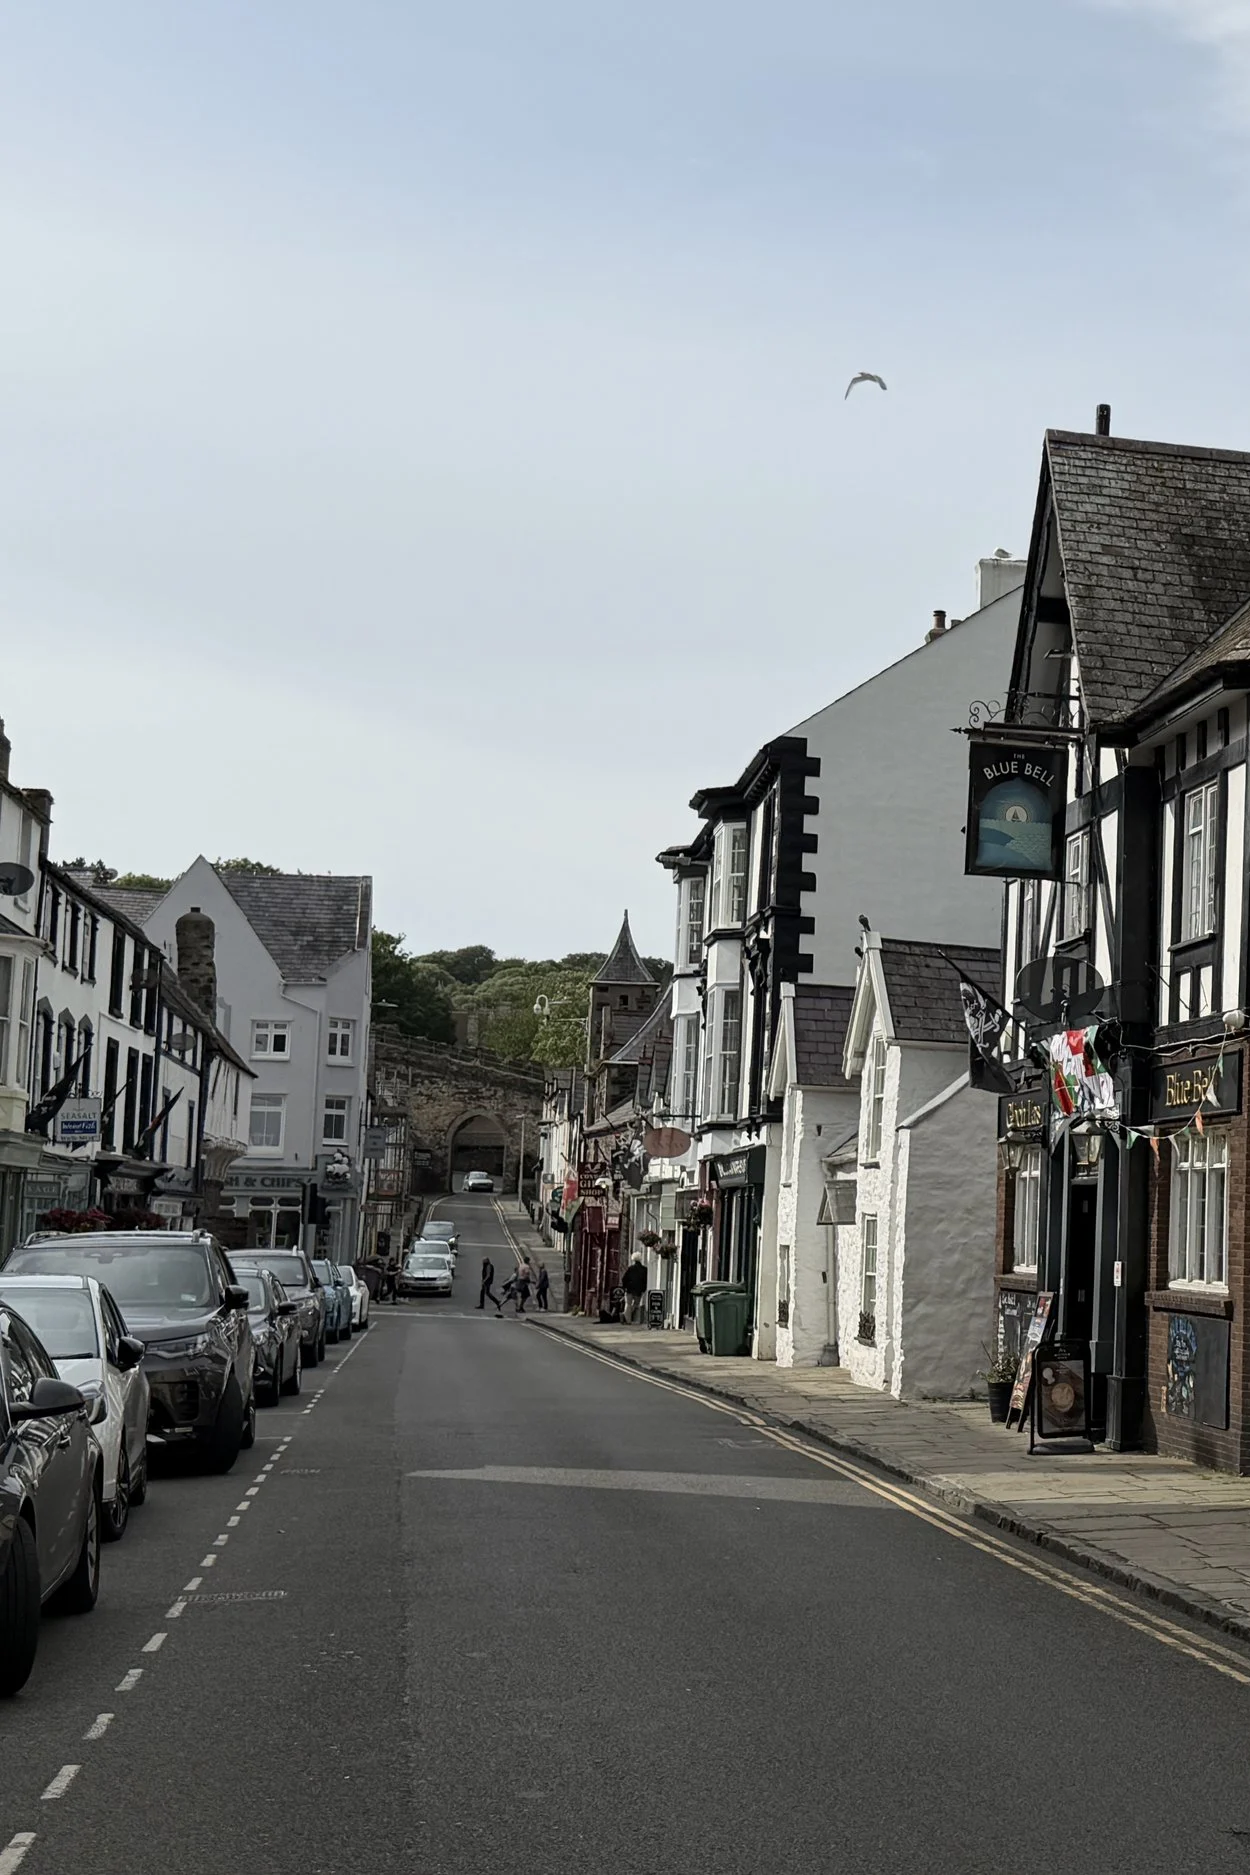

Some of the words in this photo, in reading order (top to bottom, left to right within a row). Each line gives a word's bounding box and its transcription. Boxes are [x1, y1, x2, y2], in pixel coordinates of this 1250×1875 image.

[983, 761, 1018, 780] BLUE
[1024, 762, 1055, 787] BELL
[1165, 1072, 1191, 1106] Blue
[244, 1176, 257, 1187] &
